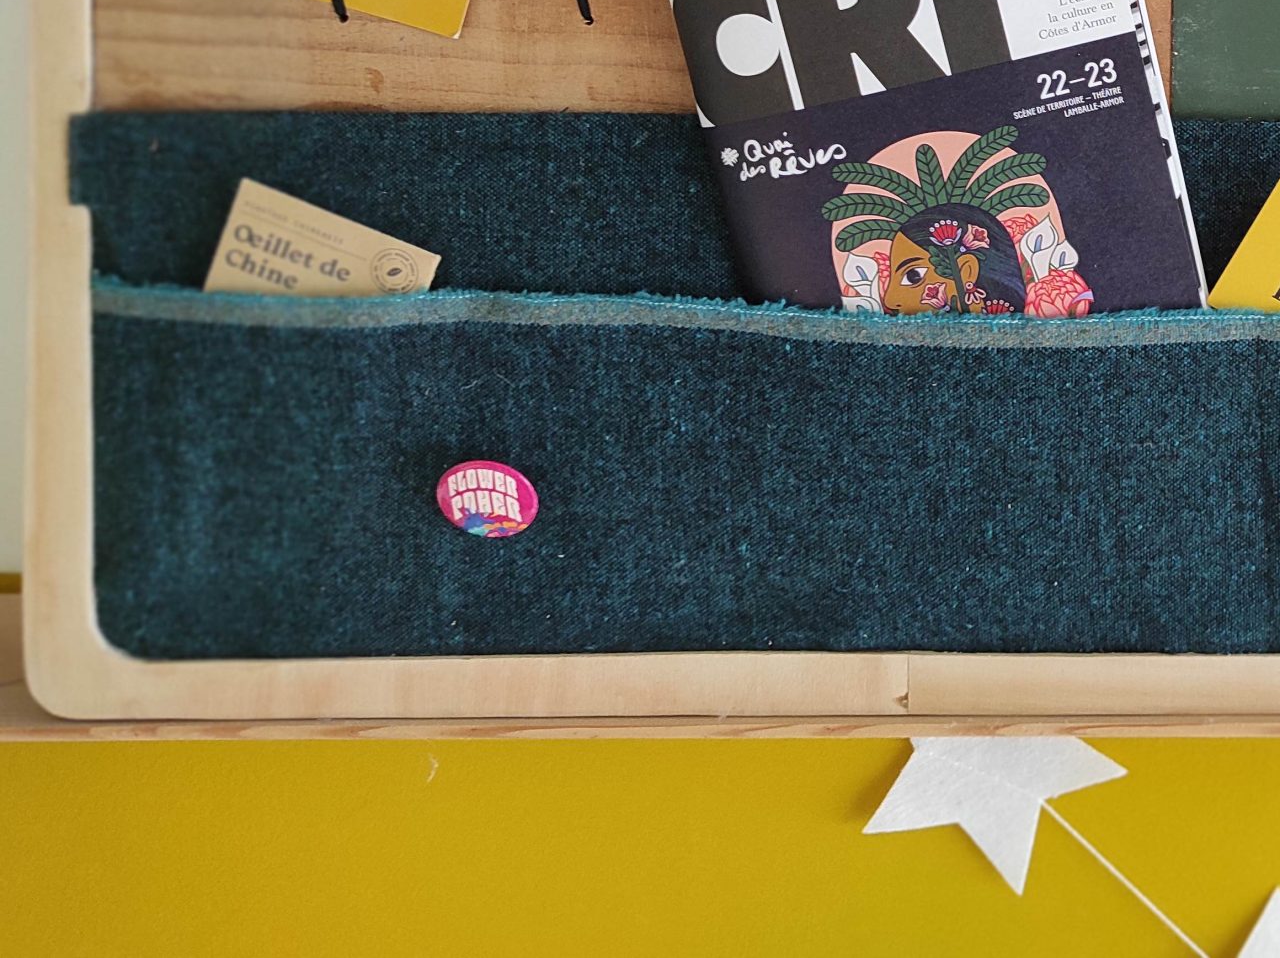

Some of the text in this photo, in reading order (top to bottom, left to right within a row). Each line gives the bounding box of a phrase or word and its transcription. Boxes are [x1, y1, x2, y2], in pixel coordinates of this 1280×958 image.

[1038, 14, 1117, 40] Côtes d'Armor
[1048, 1, 1114, 23] la culture en
[1013, 107, 1037, 120] SCÈNE
[1036, 105, 1046, 114] DE
[1046, 95, 1086, 112] TERRITOIRE
[1092, 86, 1122, 100] THÉÂTRE
[1063, 96, 1125, 118] LAMBALLE-ARMOR
[743, 131, 793, 162] Quai
[739, 161, 767, 182] des
[233, 223, 315, 269] Œillet
[319, 259, 351, 282] de
[224, 248, 299, 290] Chine
[447, 468, 519, 499] FLOWER
